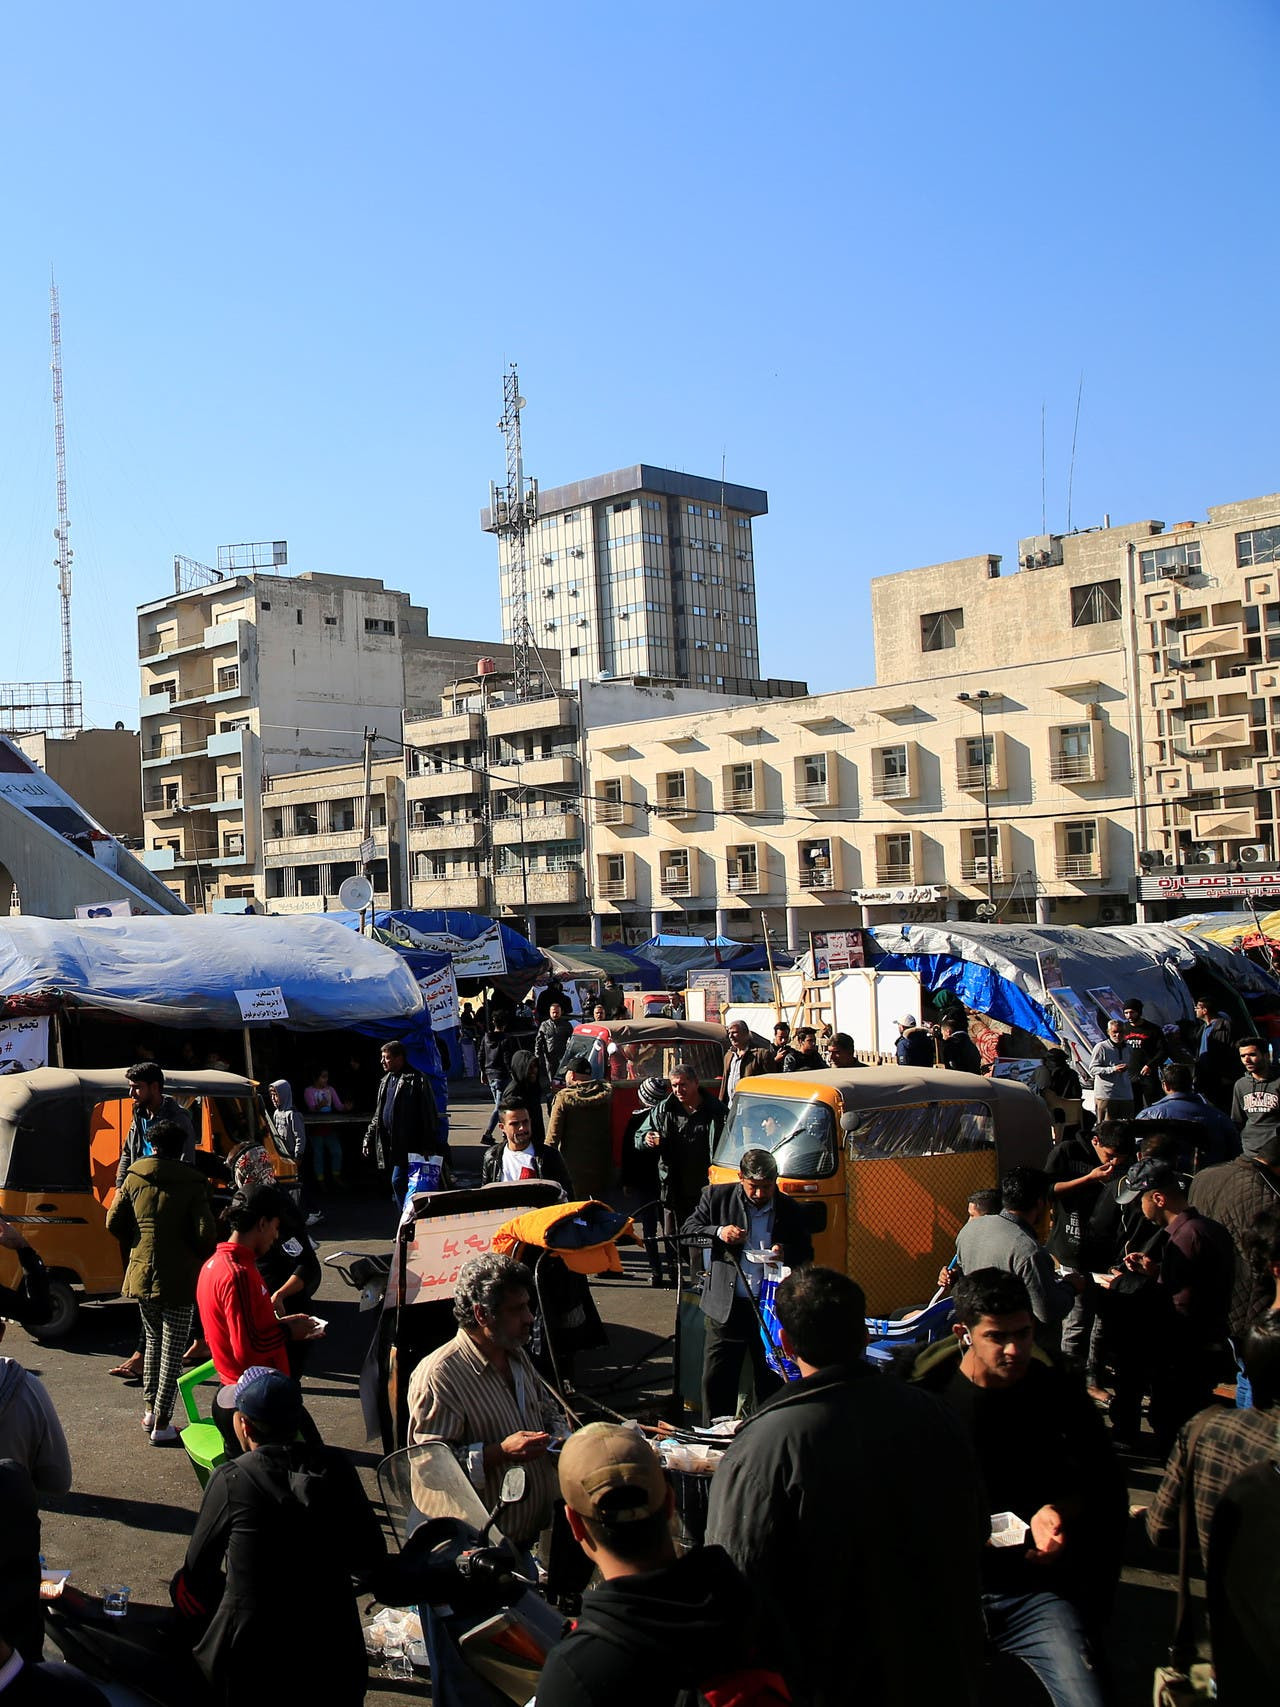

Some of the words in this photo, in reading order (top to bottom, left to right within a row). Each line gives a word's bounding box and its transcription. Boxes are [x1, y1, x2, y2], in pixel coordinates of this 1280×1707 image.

[1158, 876, 1226, 890] عمارة
[1205, 888, 1247, 899] عسكرية
[17, 1019, 39, 1033] تجمع
